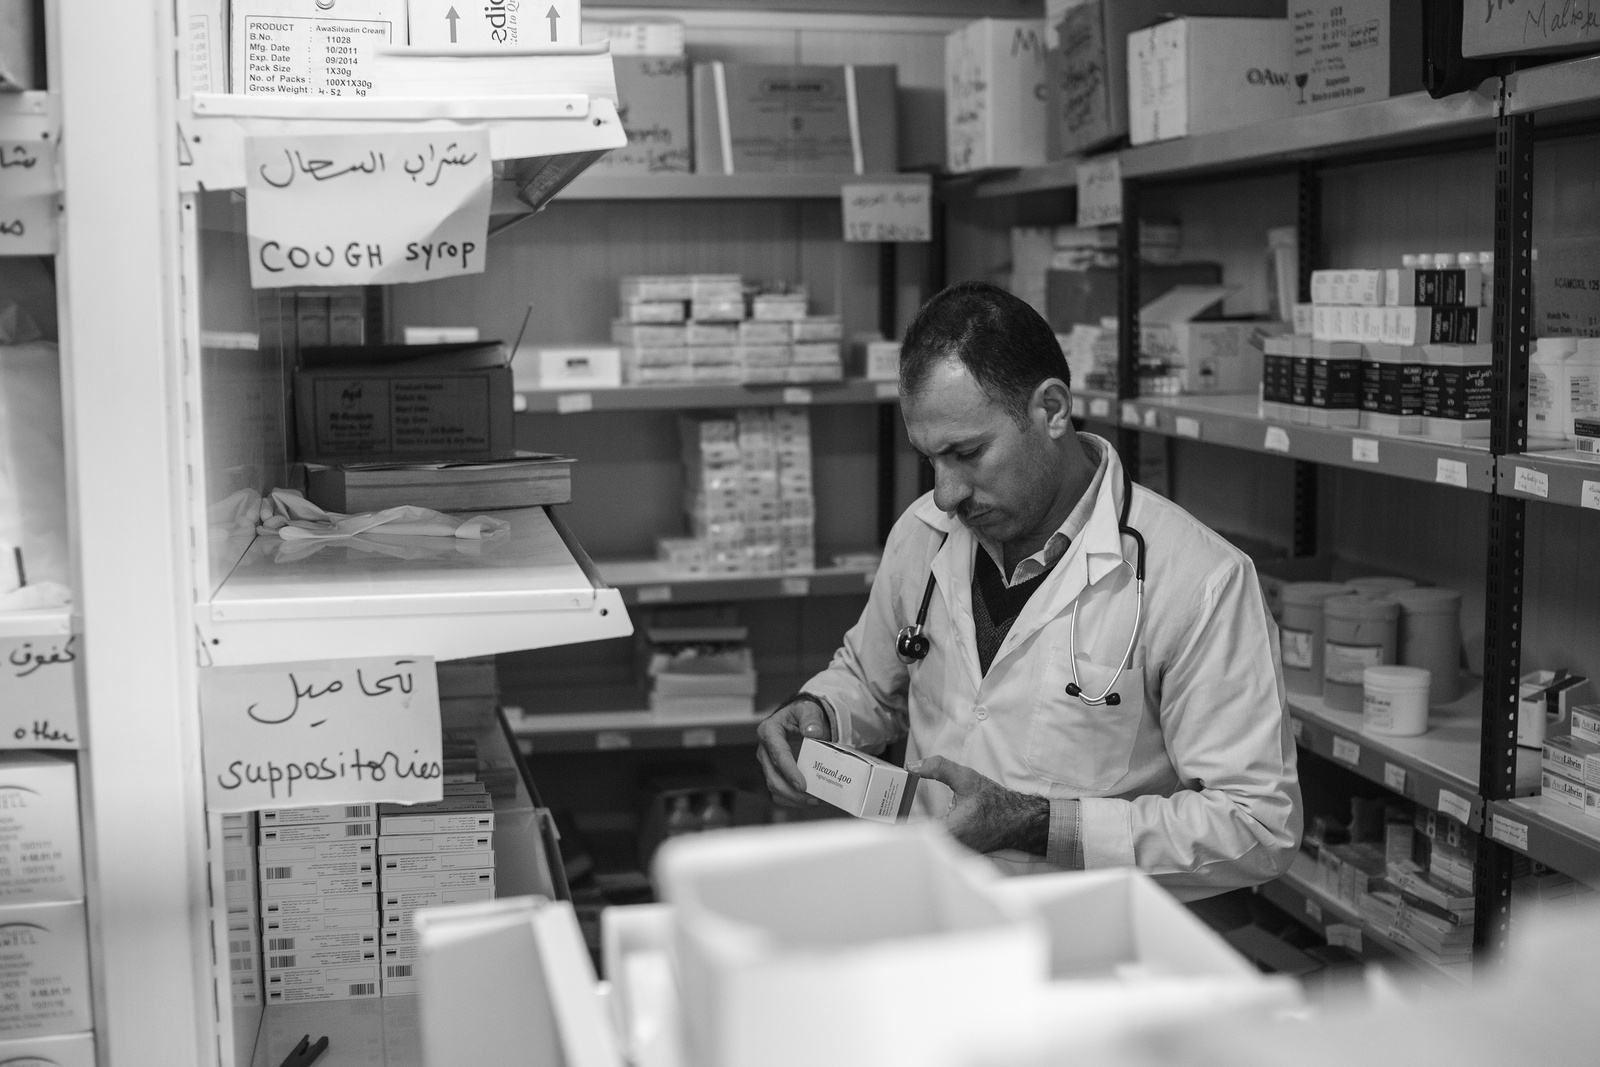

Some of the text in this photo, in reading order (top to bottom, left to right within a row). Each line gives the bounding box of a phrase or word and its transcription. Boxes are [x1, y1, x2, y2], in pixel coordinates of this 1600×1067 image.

[249, 22, 386, 35] PRODUCT AwaSilvadin Cream
[249, 33, 351, 44] B.No. 11028
[249, 43, 358, 55] Mfg. Date 10/2011
[249, 54, 358, 65] Exp. Date 09/2014
[249, 64, 352, 77] Pack Size 1X30g
[249, 74, 264, 82] No.
[280, 75, 306, 83] Packs
[326, 79, 373, 89] 100X1X30g
[249, 84, 276, 93] Gross
[277, 85, 308, 95] Weight
[355, 88, 367, 97] kg
[260, 241, 475, 272] COUGH syrop
[1551, 751, 1582, 770] AwaLibrin
[812, 760, 852, 785] Micazol 400
[1551, 779, 1583, 799] AwaLibrin
